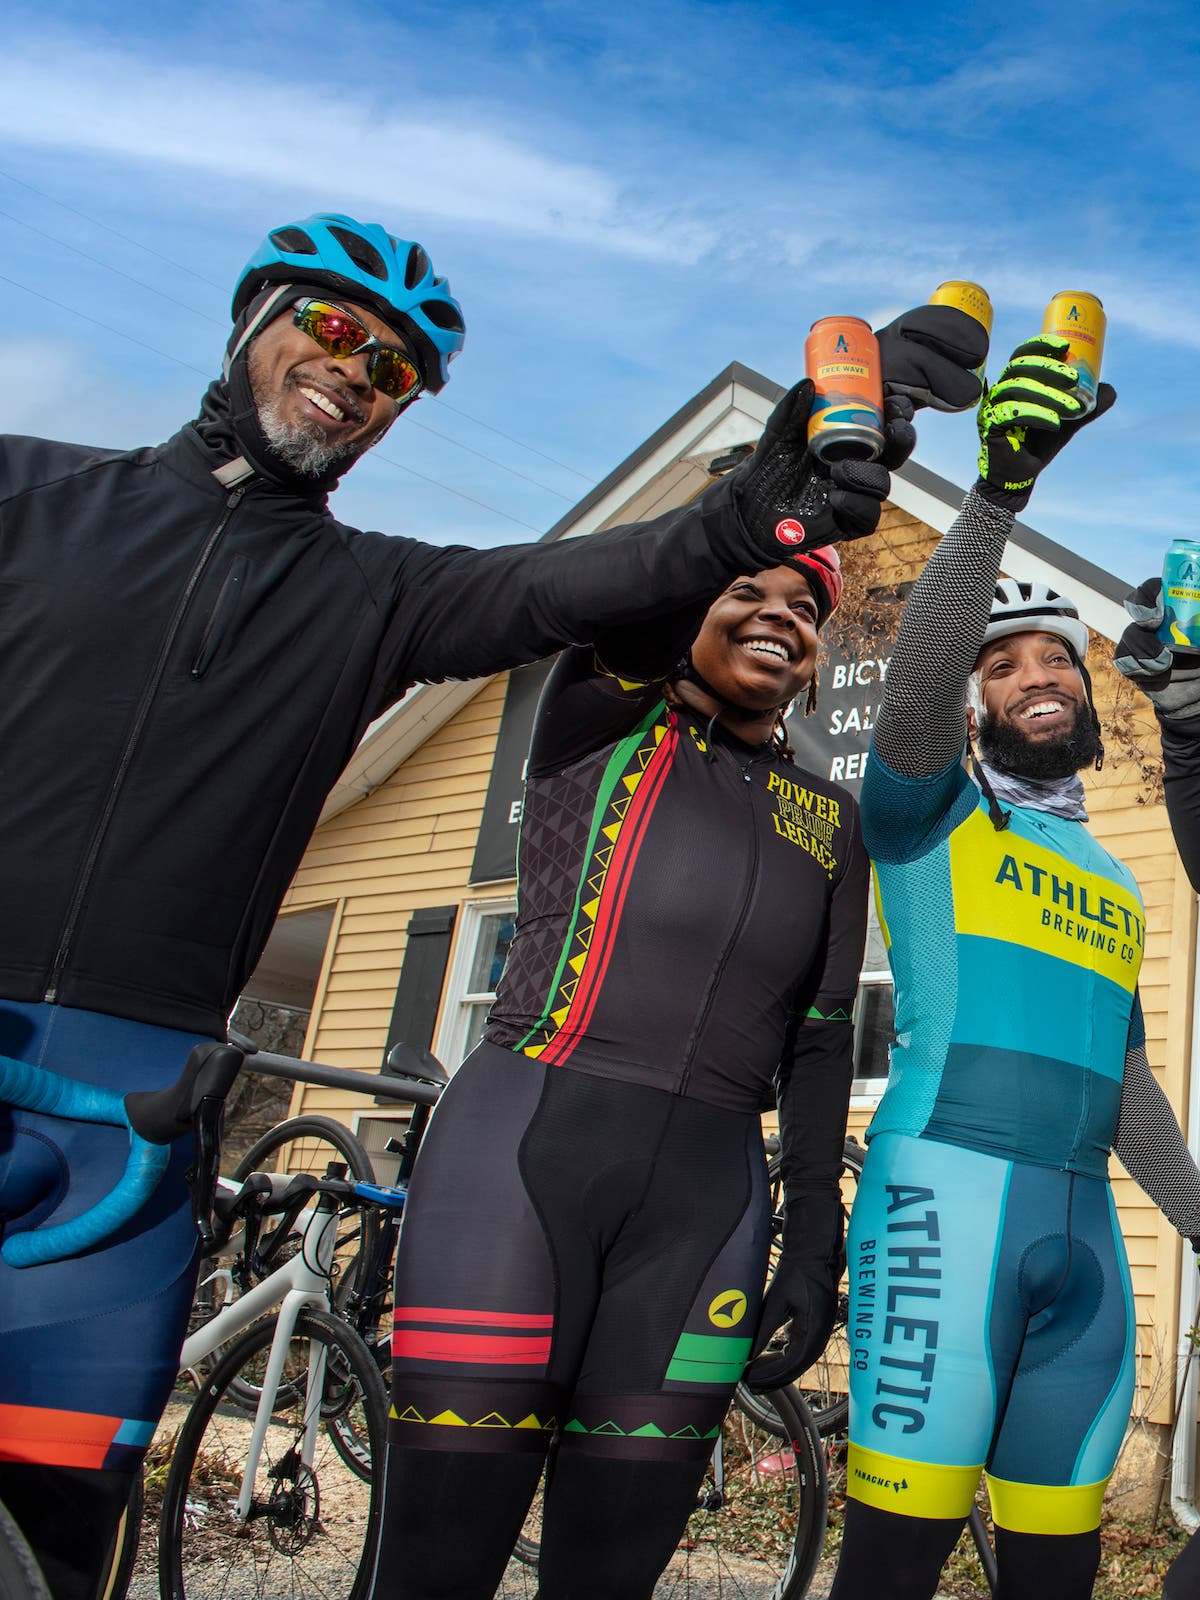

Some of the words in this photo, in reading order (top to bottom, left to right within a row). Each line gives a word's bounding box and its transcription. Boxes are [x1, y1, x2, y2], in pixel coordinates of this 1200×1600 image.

[843, 366, 865, 374] WAVE
[1185, 591, 1200, 599] WILD
[832, 657, 892, 689] BICY
[767, 771, 841, 828] POWER
[776, 795, 835, 851] PRIDE
[995, 854, 1145, 948] ATHLETI
[1041, 908, 1116, 954] BREWING
[855, 1239, 876, 1340] BREWING
[872, 1184, 942, 1434] ATHLETIC
[854, 1468, 891, 1488] PANACHE
